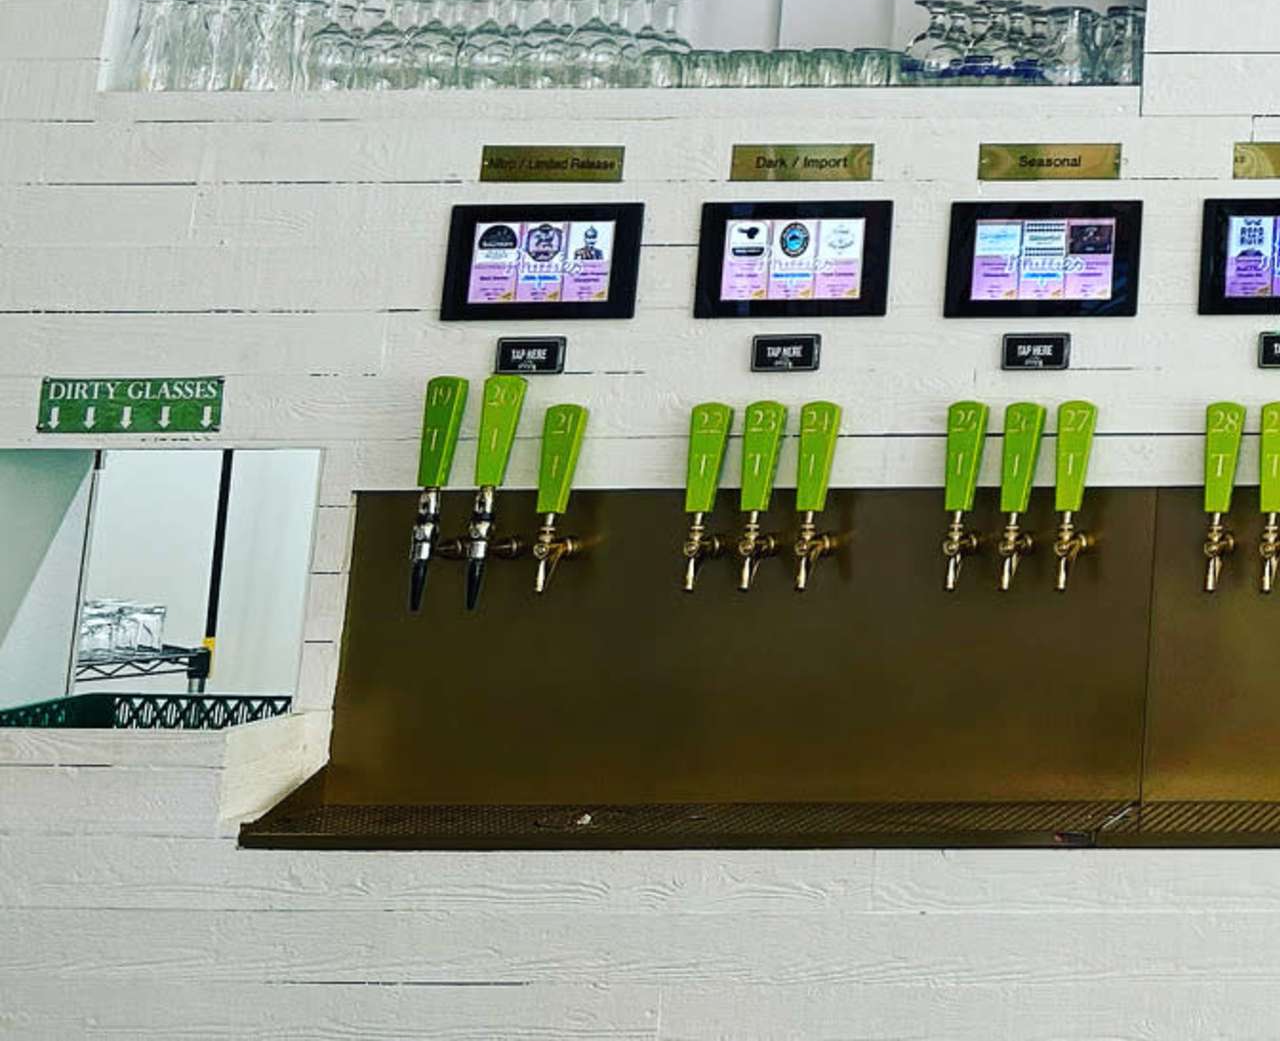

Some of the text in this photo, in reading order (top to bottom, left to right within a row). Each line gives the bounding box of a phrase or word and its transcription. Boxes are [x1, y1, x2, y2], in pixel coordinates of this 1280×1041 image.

[756, 156, 788, 168] Dark
[804, 155, 849, 170] Import
[1018, 155, 1081, 167] Seasonal
[49, 380, 218, 400] DIRTY GLASSES
[1212, 410, 1240, 432] 28
